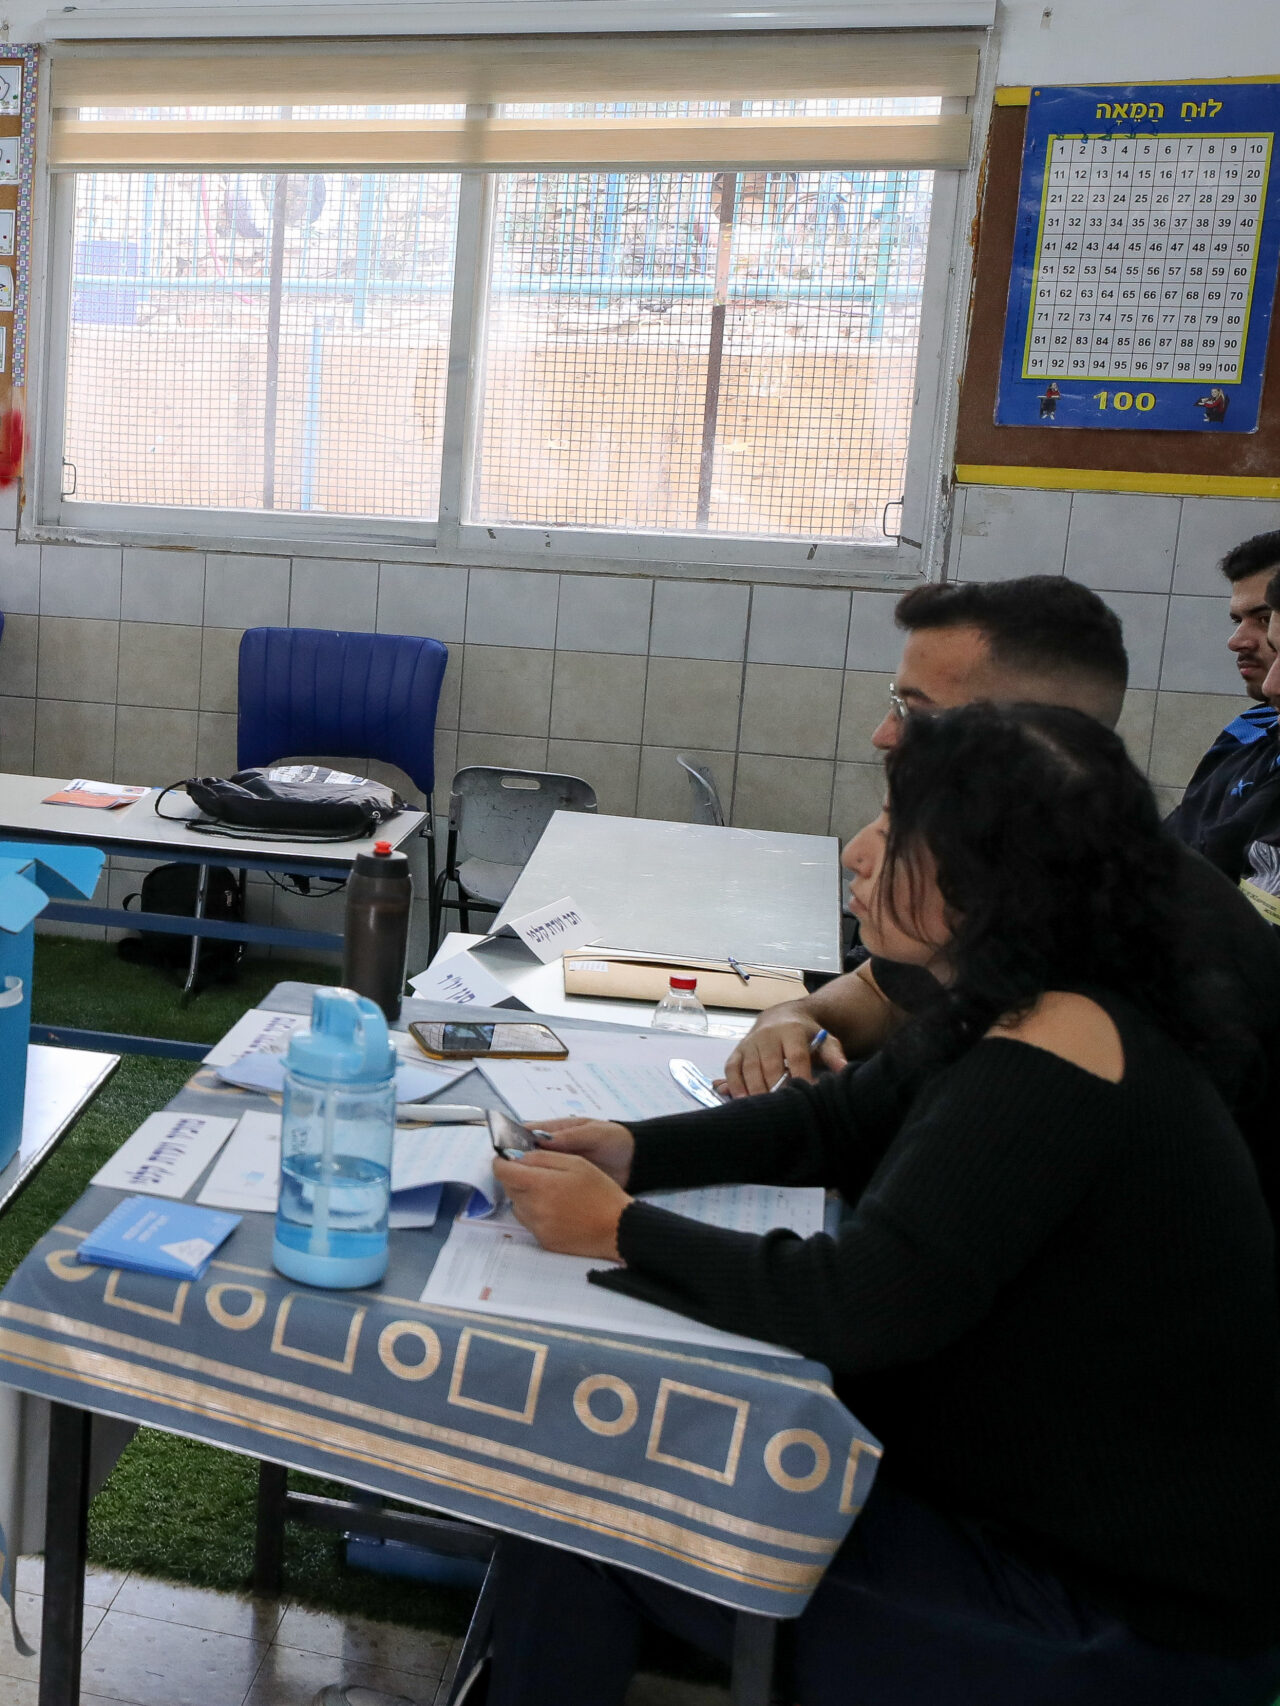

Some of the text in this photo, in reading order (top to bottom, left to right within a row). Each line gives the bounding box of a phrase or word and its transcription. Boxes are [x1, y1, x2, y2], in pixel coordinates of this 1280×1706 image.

[1059, 144, 1263, 155] 1 2 3 4 5 6 7 8 9 10
[1054, 169, 1261, 179] 11 12 13 14 15 16 17 18 19 20
[1050, 193, 1257, 204] 21 22 23 24 25 26 27 28 29 30
[1047, 217, 1254, 228] 31 32 33 34 35 36 37 38 39 40
[1044, 241, 1250, 253] 41 42 43 44 45 46 47 48 49 50
[1042, 265, 1248, 277] 51 52 53 54 55 56 57 58 59 60
[1039, 288, 1244, 301] 61 62 63 64 65 66 67 68 69 70
[1037, 312, 1241, 325] 71 72 73 74 75 76 77 78 79 80
[1034, 335, 1238, 349] 81 82 83 84 85 86 87 88 89 90
[1031, 358, 1237, 373] 91 92 93 94 95 96 97 98 99 100
[1093, 391, 1157, 412] 100
